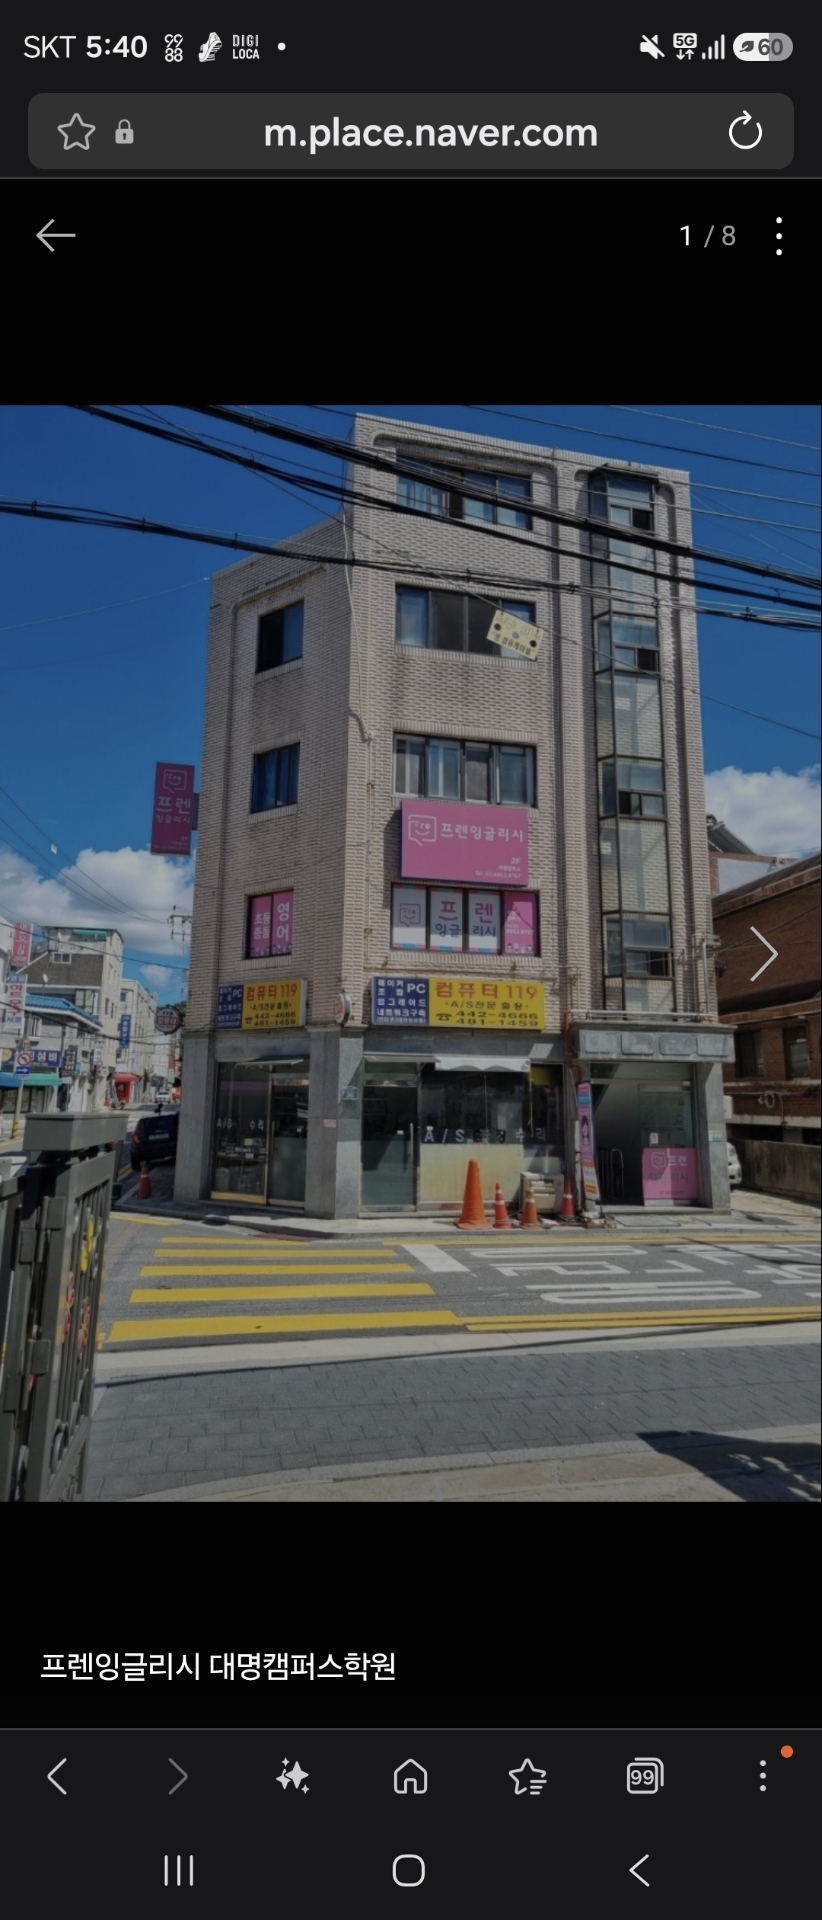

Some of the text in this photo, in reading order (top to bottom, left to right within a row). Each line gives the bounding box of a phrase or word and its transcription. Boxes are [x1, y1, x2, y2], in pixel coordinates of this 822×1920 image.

[156, 796, 191, 814] 프렌
[440, 823, 523, 843] 프렌잉글리시
[254, 913, 271, 925] 초등
[276, 902, 290, 942] 영어
[253, 925, 270, 940] 중등
[233, 988, 242, 998] PC
[246, 984, 277, 1002] 컴퓨터
[280, 983, 298, 998] 119
[407, 983, 426, 994] PC
[435, 982, 537, 999] 컴퓨터 119
[255, 1011, 296, 1019] 442-4666
[456, 1010, 538, 1019] 442-4666
[254, 1018, 296, 1026] 481-1459
[456, 1018, 538, 1027] 481-1459
[424, 1128, 465, 1143] A/S
[668, 1155, 687, 1166] 프렌
